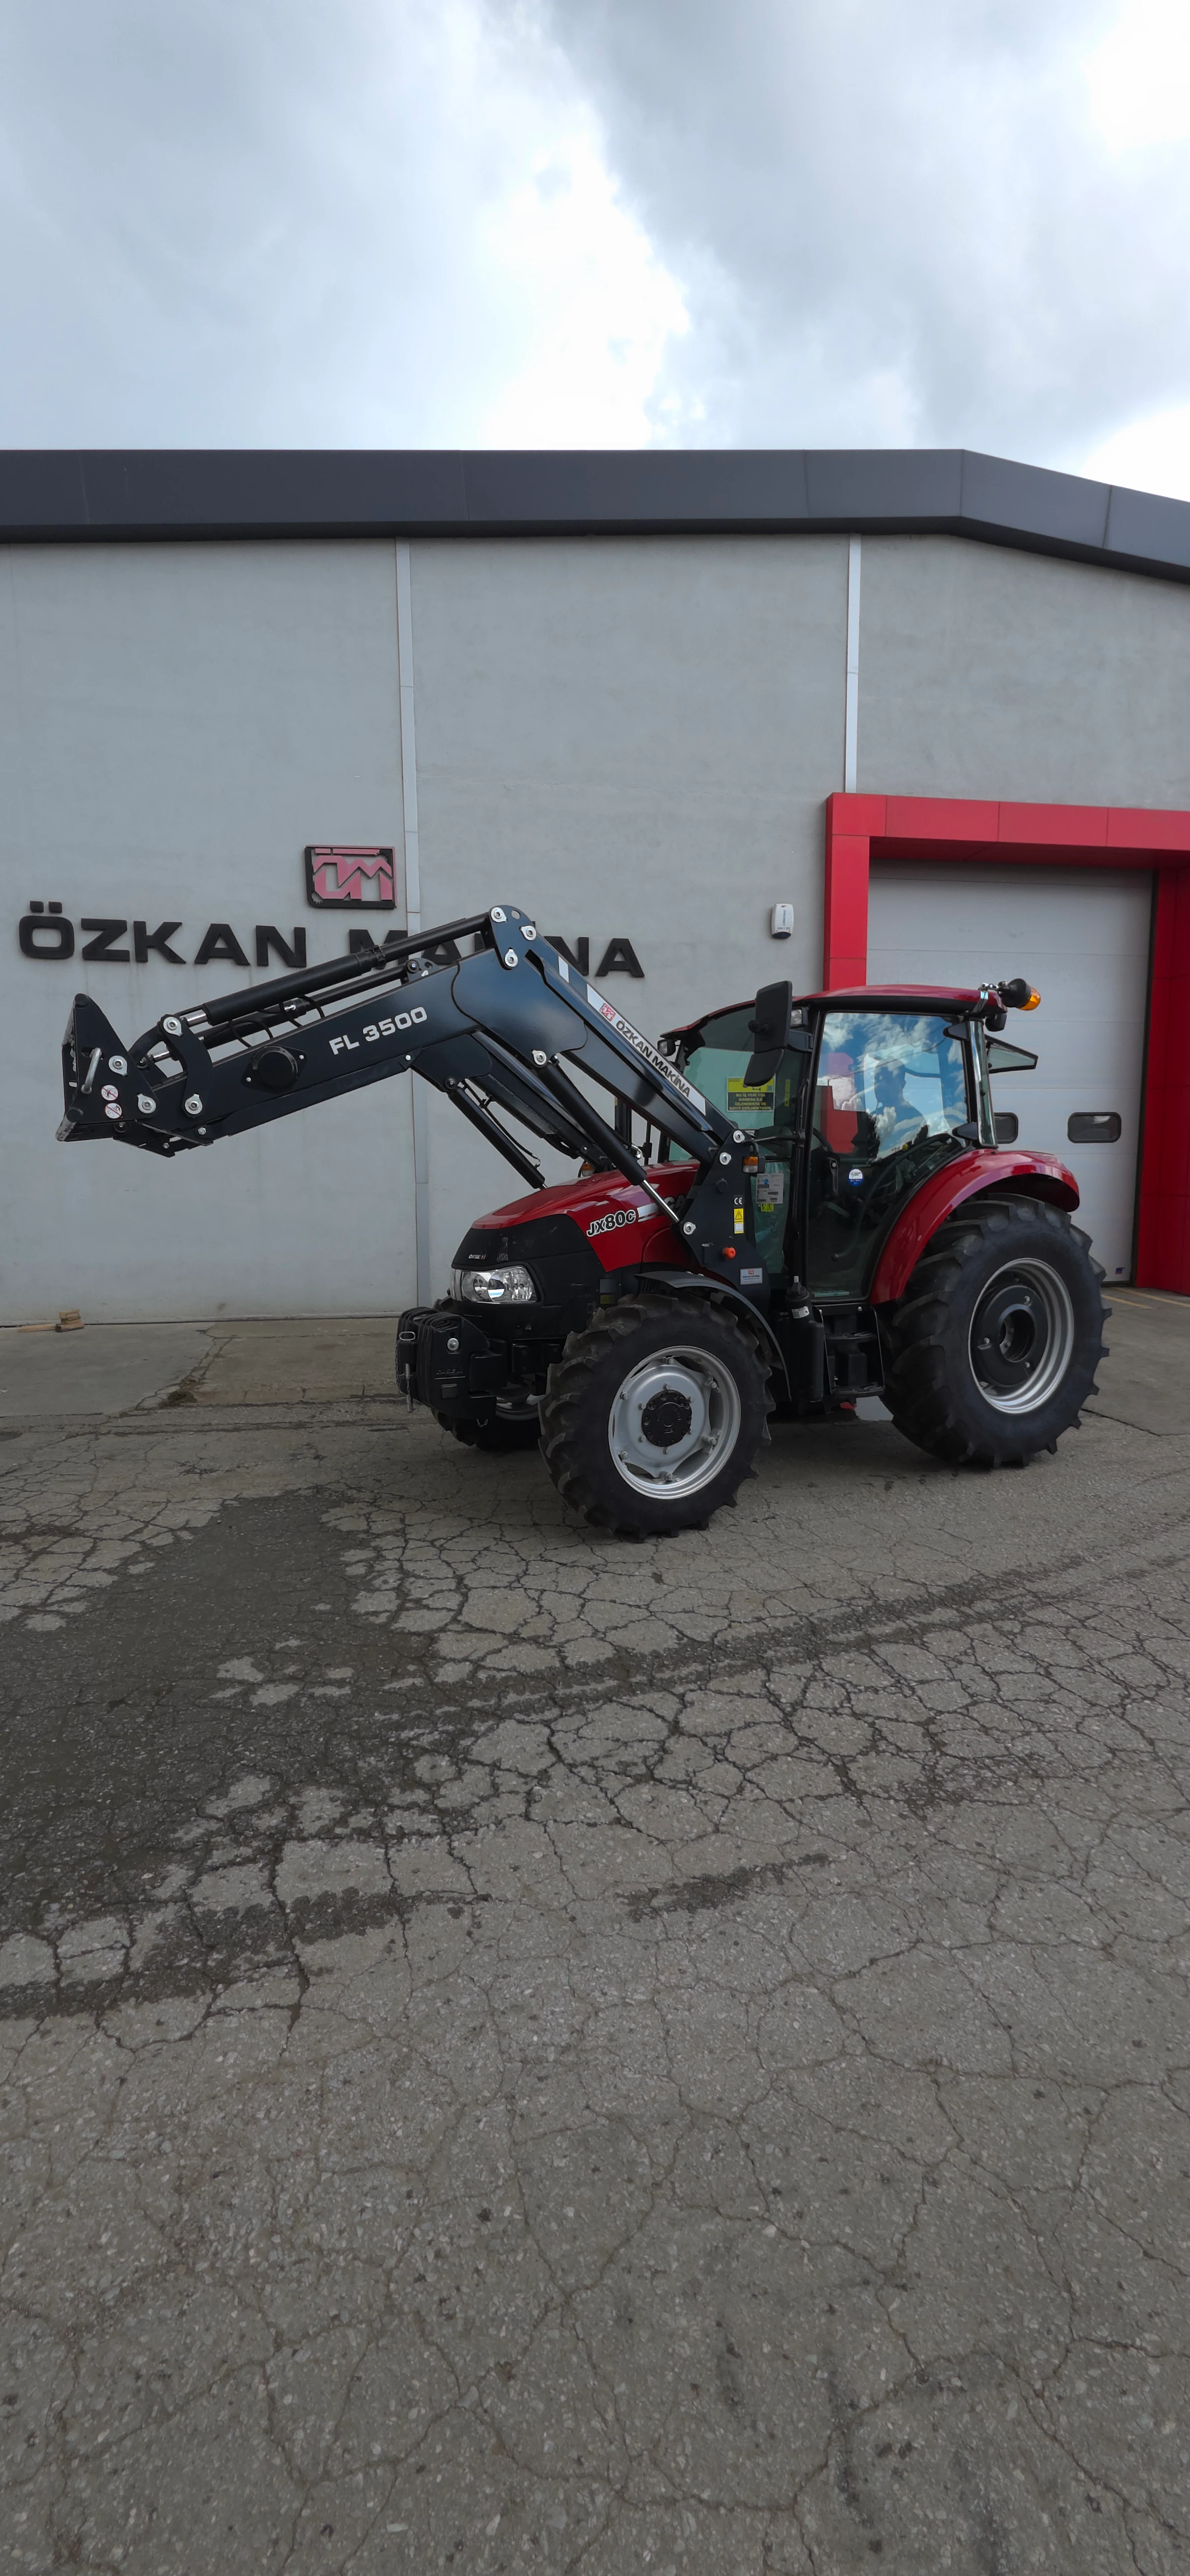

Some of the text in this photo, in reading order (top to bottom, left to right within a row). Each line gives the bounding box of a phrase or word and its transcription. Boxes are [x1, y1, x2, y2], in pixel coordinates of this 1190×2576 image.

[19, 901, 307, 968] ÖZKAN
[329, 1007, 427, 1055] FL 3500
[616, 1019, 691, 1098] ÖZKAN MAKİNA
[586, 1209, 636, 1237] JX80C
